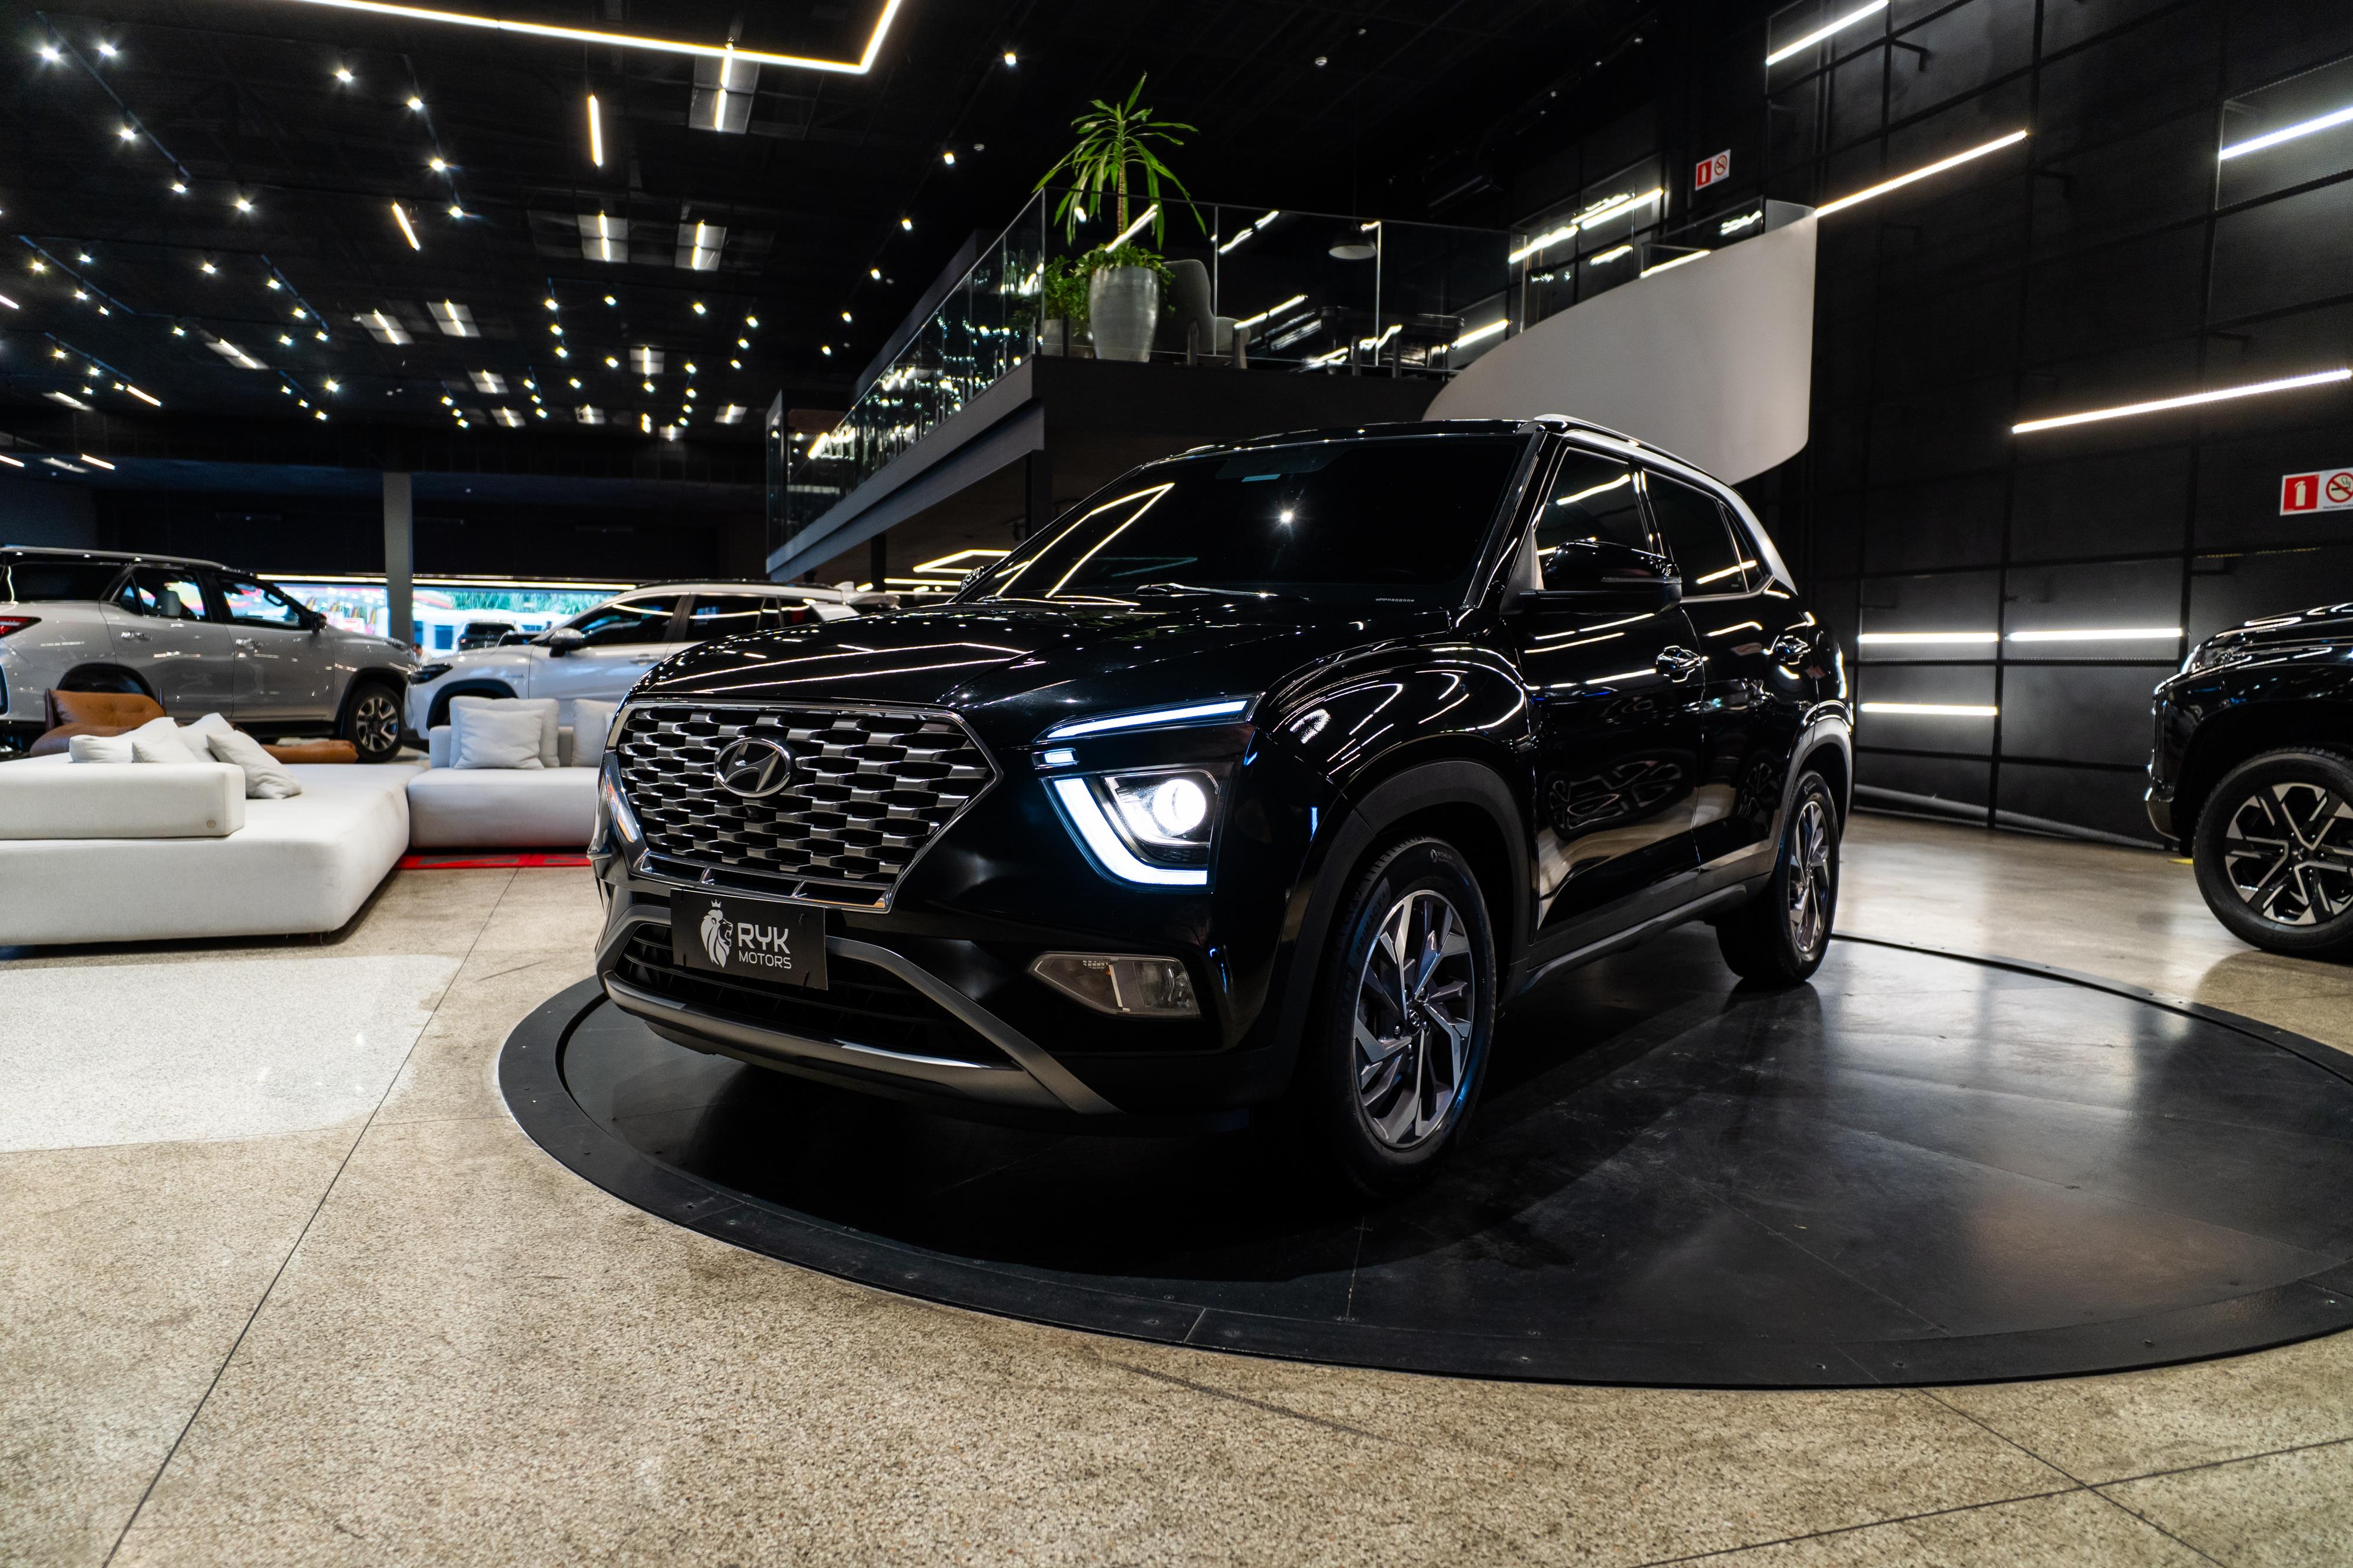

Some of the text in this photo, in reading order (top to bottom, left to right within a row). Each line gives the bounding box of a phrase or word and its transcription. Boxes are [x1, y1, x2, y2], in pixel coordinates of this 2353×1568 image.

[737, 922, 790, 954] RYK
[1356, 897, 1382, 957] PRIMACY
[739, 950, 792, 969] MOTORS
